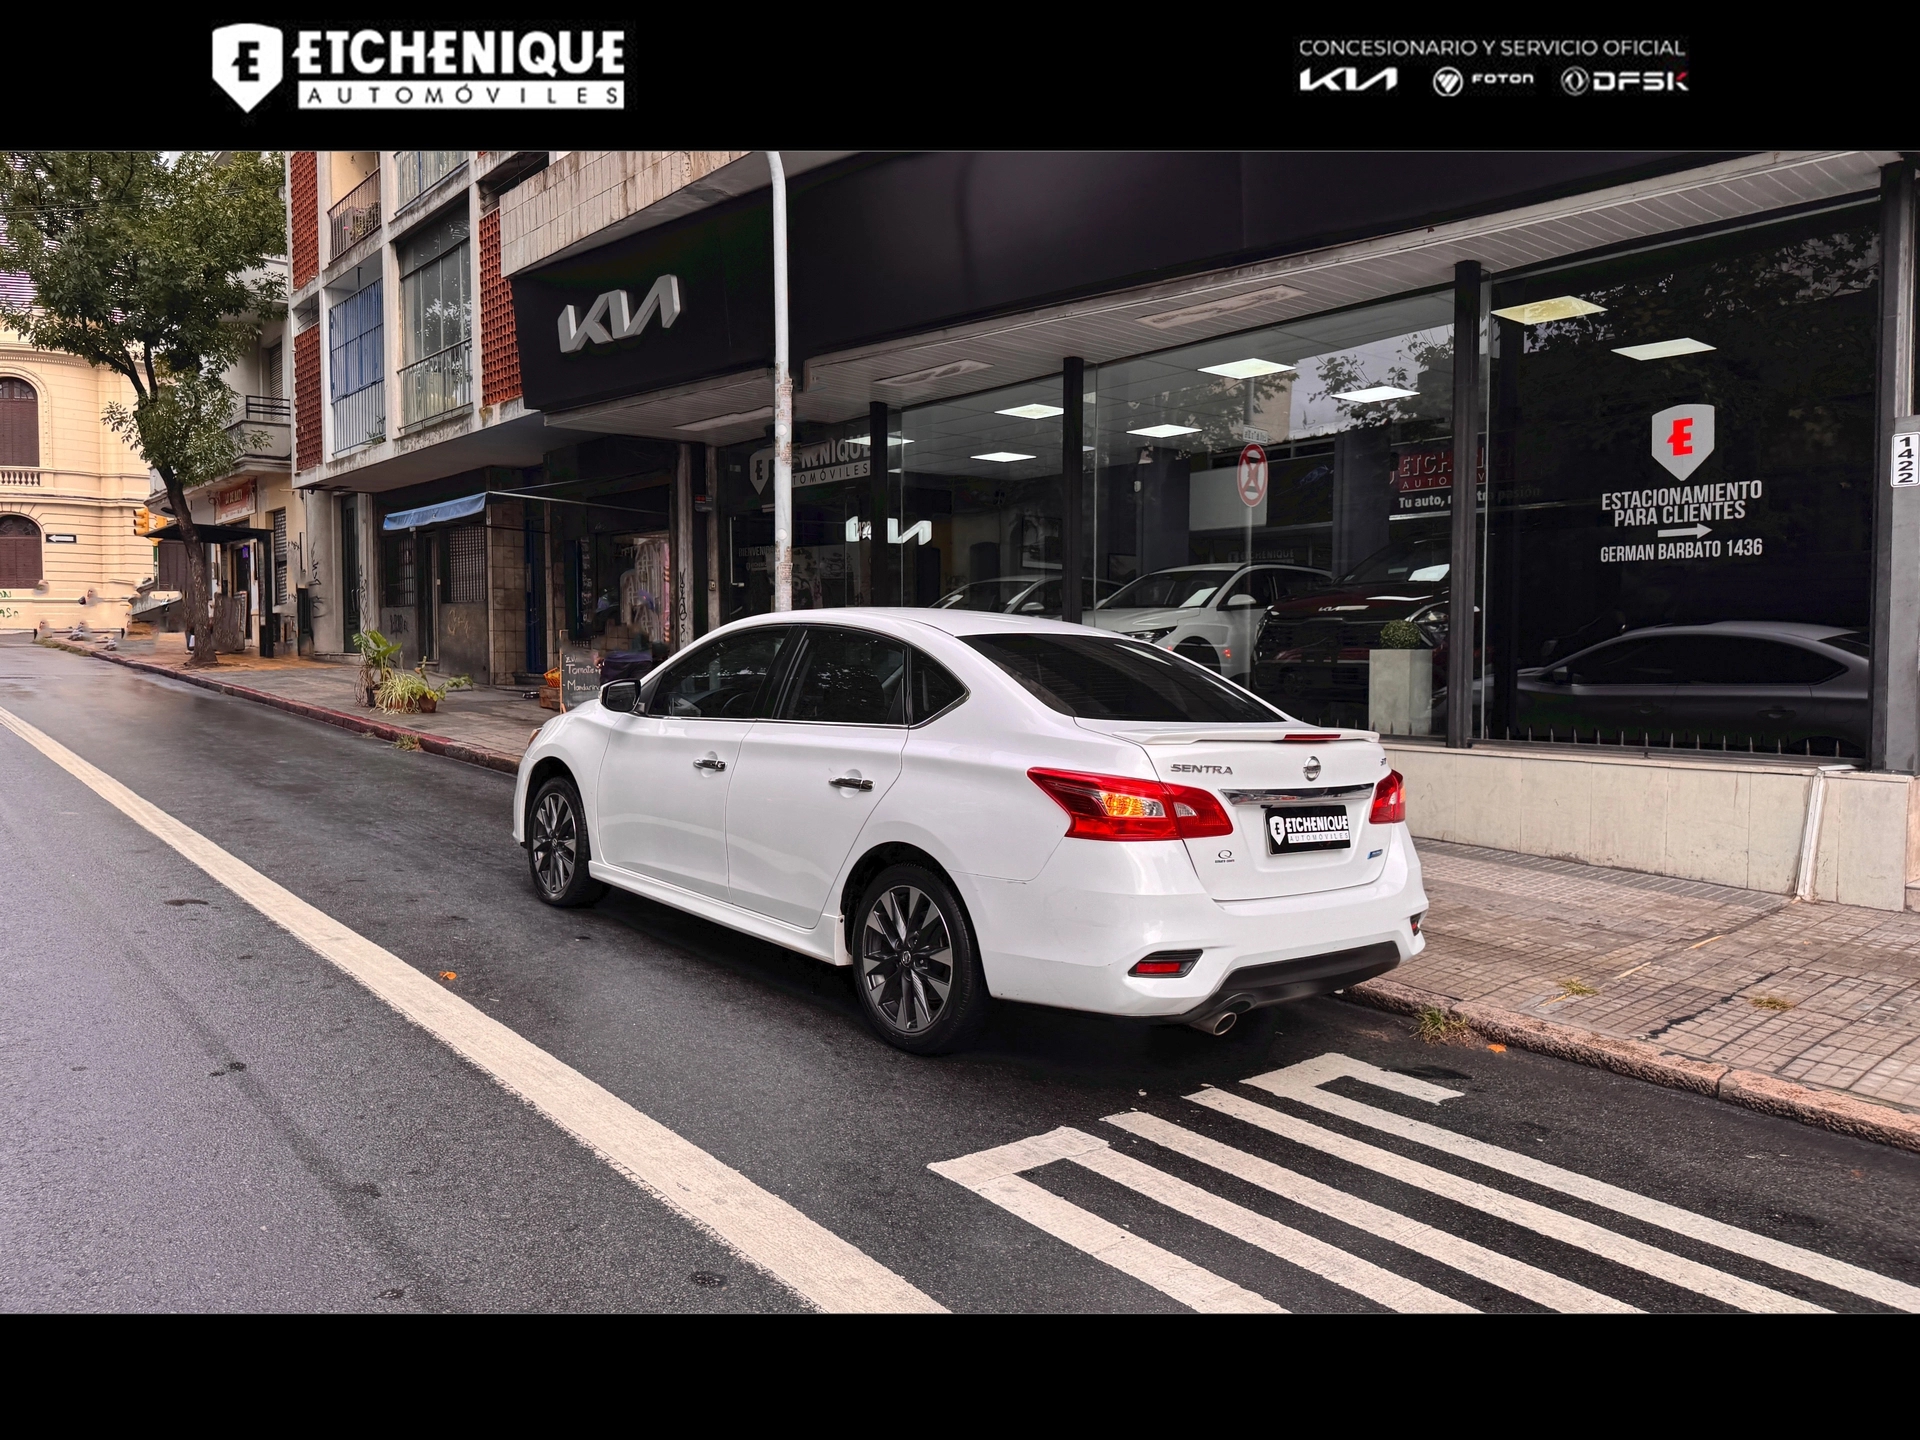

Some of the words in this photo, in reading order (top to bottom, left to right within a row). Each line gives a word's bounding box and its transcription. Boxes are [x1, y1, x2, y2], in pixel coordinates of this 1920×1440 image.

[557, 273, 681, 354] KIA
[792, 462, 869, 486] TOMÓVILES
[1399, 497, 1412, 509] Tu
[1414, 495, 1445, 508] auto,
[1601, 480, 1763, 511] ESTACIONAMIENTO
[1614, 507, 1658, 528] PARA
[1662, 500, 1746, 524] CLIENTES
[1600, 544, 1655, 563] GERMAN
[1658, 540, 1722, 560] BARBATO
[1726, 537, 1763, 556] 1436
[1170, 763, 1234, 776] SENTRA
[1285, 815, 1349, 833] ETCHENIQUE
